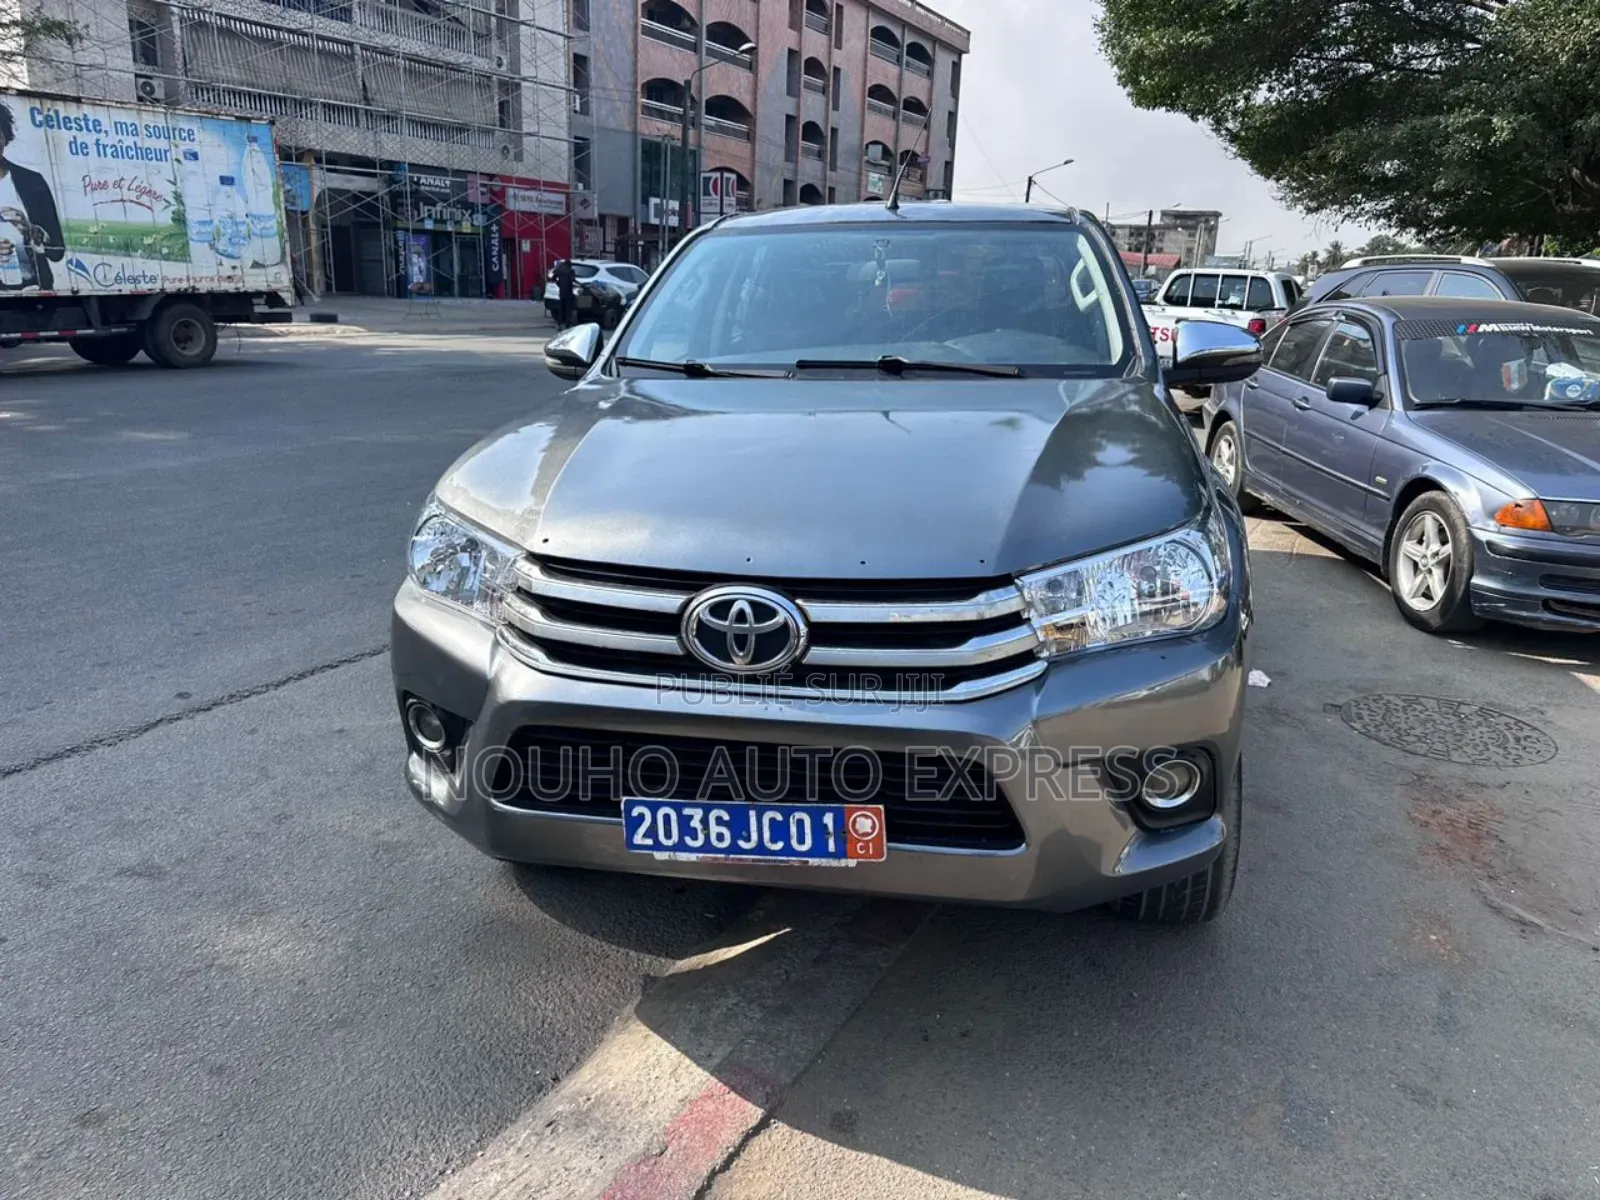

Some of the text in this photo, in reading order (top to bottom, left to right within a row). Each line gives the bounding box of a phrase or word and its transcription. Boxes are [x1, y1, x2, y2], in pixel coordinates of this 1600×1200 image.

[29, 106, 196, 143] Céleste, ma source
[68, 134, 170, 163] de fraîcheur
[82, 174, 110, 197] Pure
[113, 176, 125, 191] et
[490, 223, 500, 272] CANAL+
[93, 262, 158, 288] Céleste
